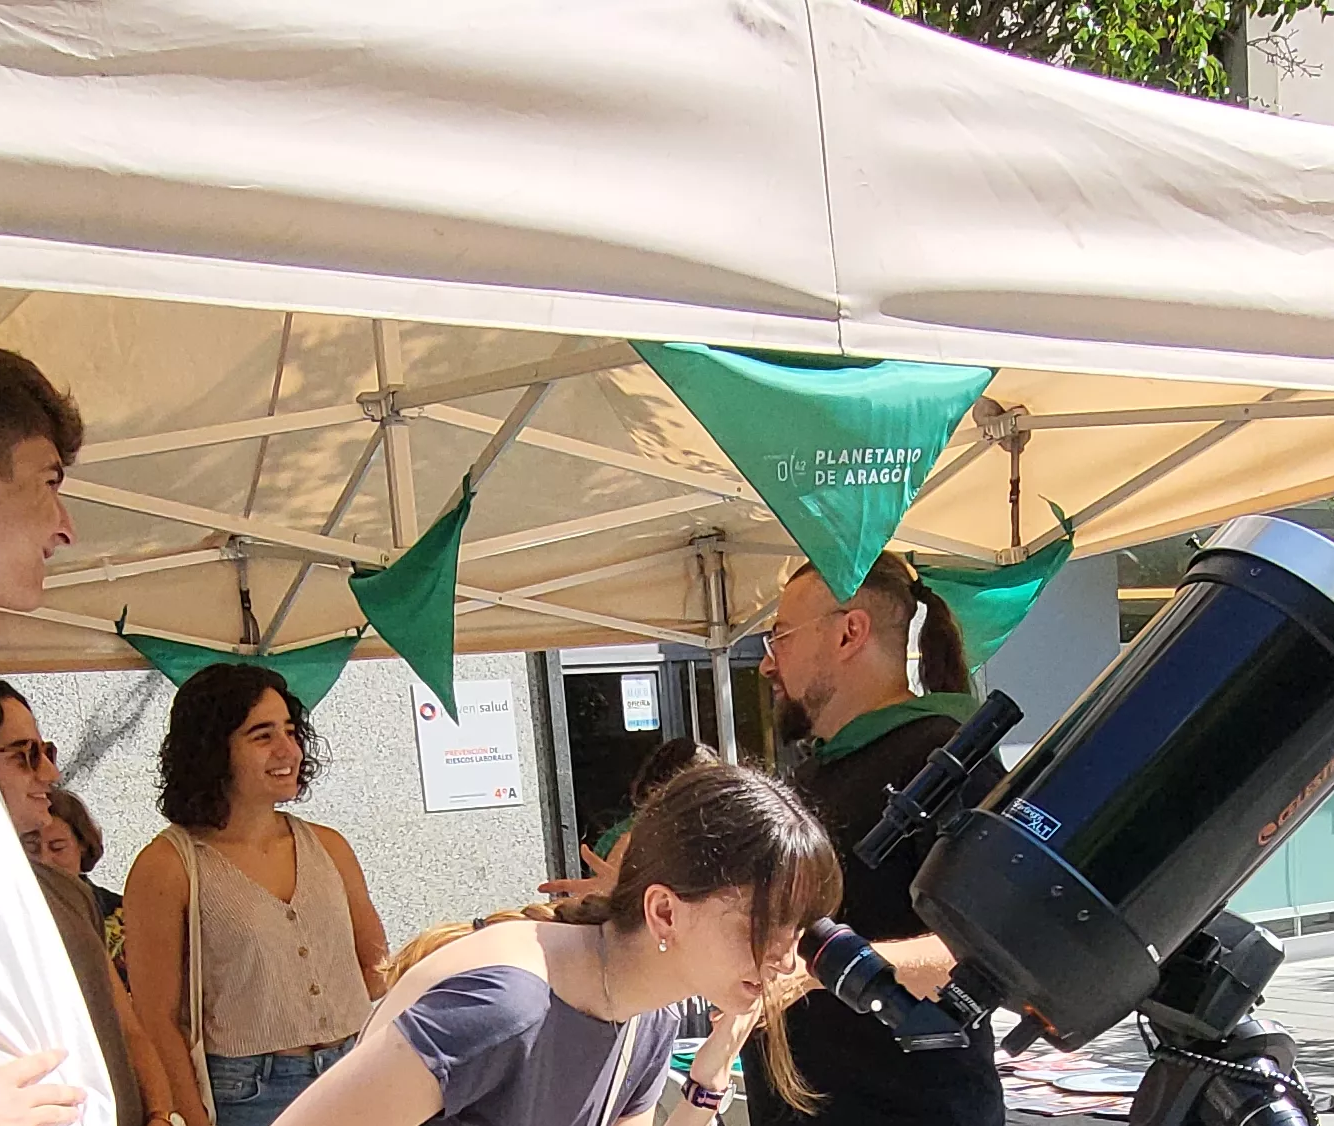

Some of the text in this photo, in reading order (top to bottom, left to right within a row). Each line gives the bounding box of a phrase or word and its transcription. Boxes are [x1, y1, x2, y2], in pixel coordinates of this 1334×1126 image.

[815, 448, 922, 465] PLANETARIO
[815, 470, 837, 486] DE
[480, 700, 509, 713] salud
[489, 746, 498, 754] DE
[475, 753, 513, 763] LABORALES
[1028, 818, 1052, 836] XLT
